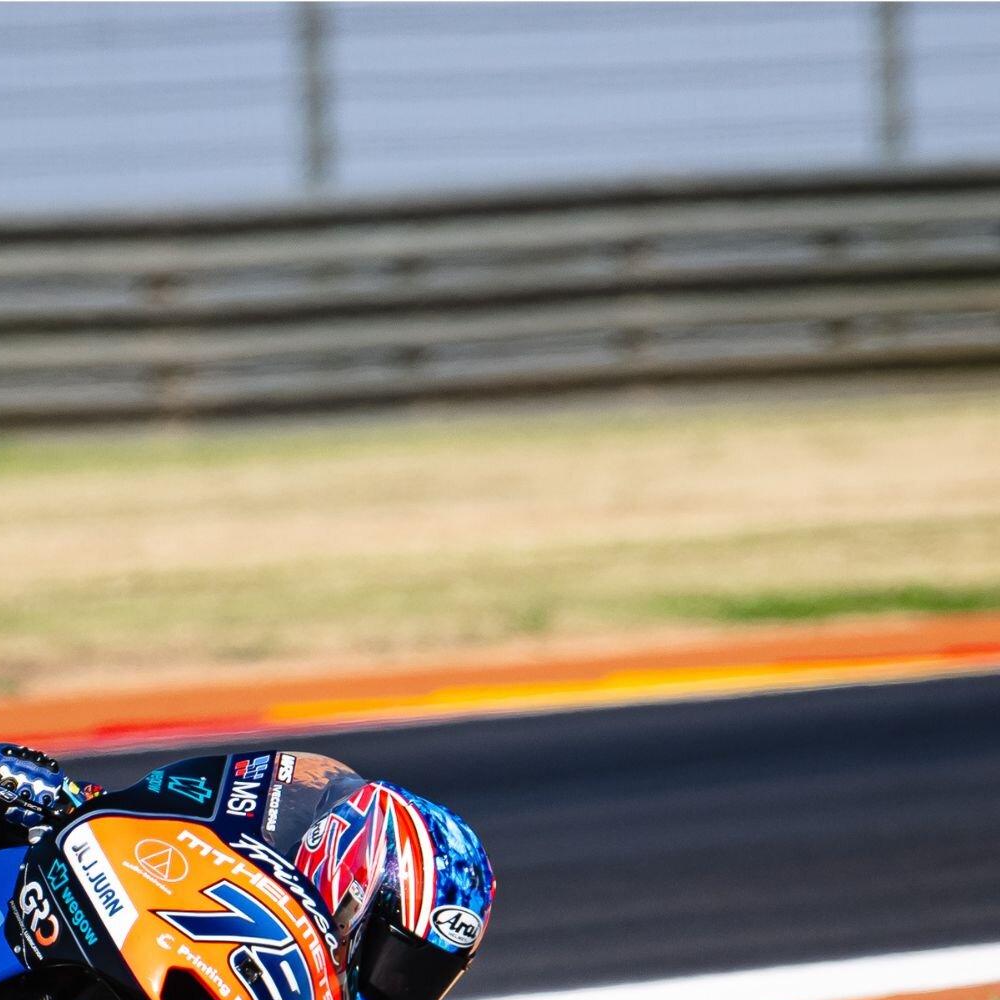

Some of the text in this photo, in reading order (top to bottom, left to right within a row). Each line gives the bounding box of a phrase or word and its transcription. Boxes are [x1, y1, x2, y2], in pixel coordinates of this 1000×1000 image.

[177, 830, 235, 869] MT
[62, 886, 98, 946] wegow
[82, 859, 125, 919] J.JUAN
[177, 944, 231, 998] Printing
